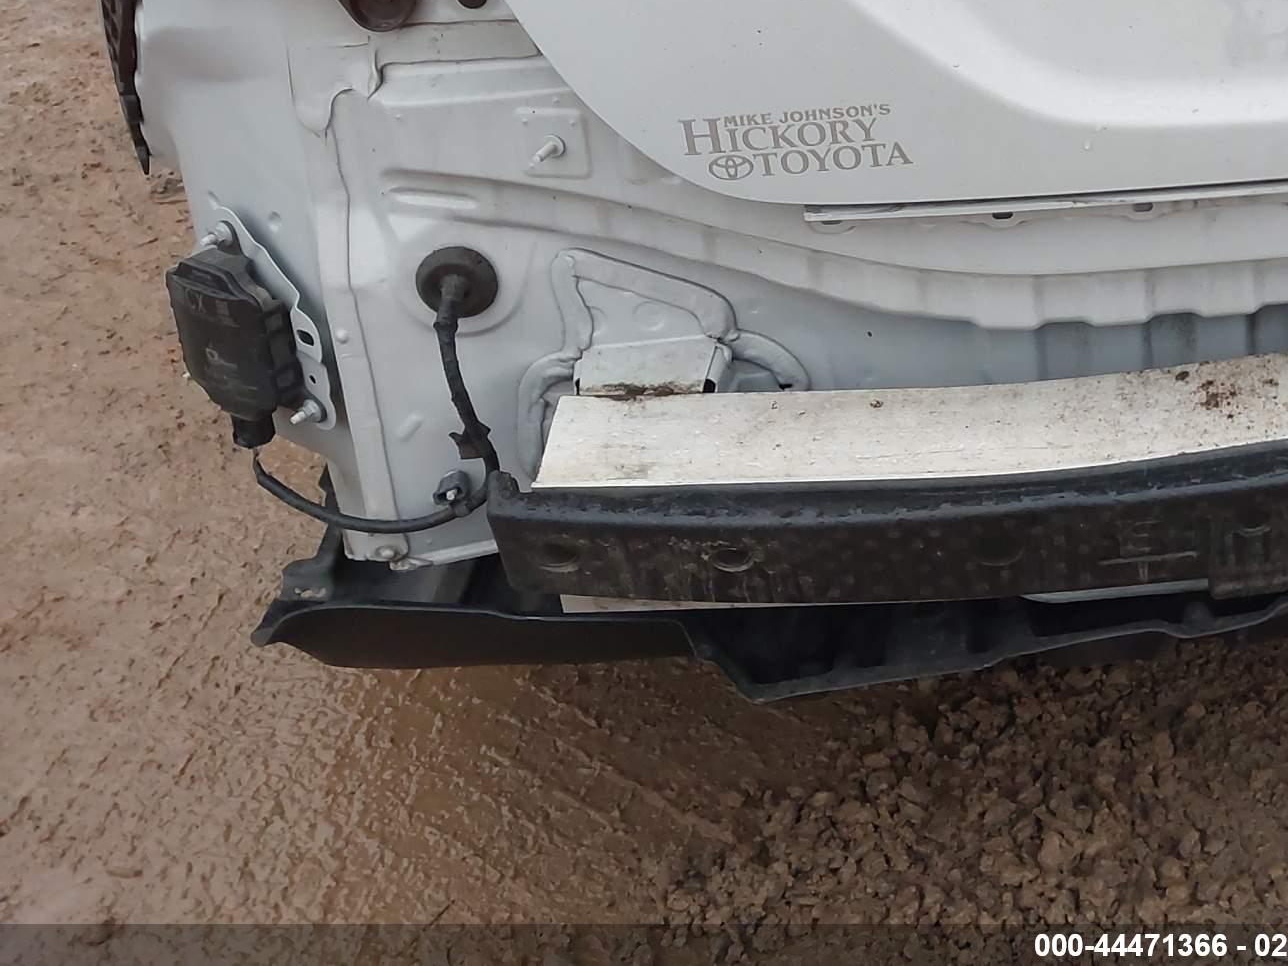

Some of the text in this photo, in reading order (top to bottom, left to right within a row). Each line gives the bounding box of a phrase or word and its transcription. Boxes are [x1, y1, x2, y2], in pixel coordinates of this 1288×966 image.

[723, 104, 891, 128] MIKE JOHNSON'S
[678, 117, 877, 156] HICKORY
[752, 141, 914, 177] TOYOTA
